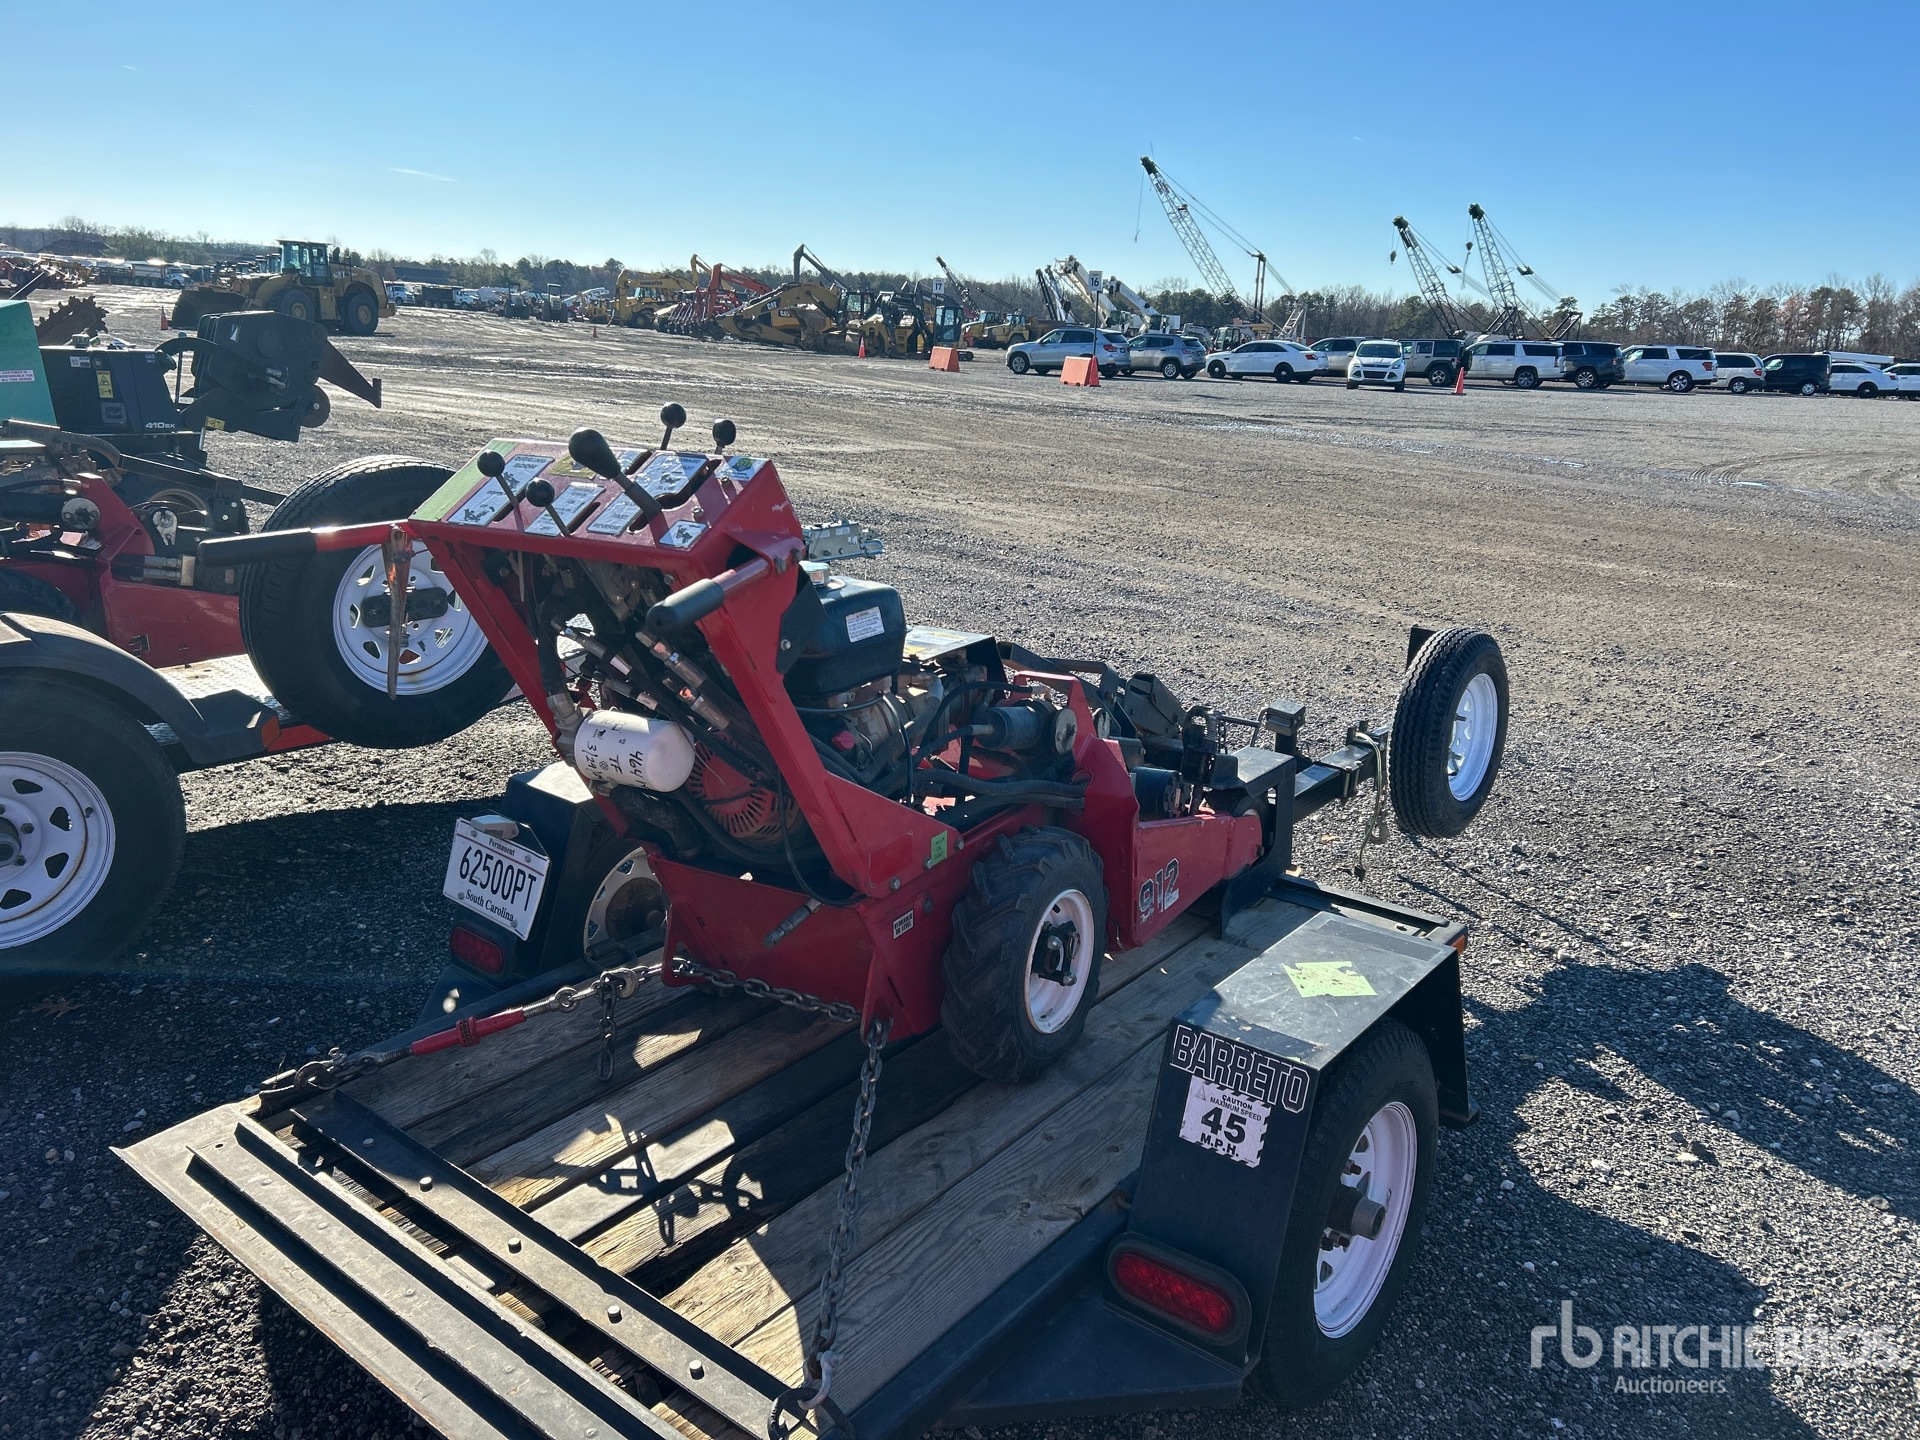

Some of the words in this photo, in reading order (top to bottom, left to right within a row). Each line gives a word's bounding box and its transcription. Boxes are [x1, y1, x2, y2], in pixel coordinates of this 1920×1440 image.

[935, 282, 942, 290] 17
[1091, 277, 1099, 287] 16
[767, 301, 777, 310] CAT
[629, 751, 643, 778] 464
[488, 838, 515, 856] Permanent
[460, 845, 537, 911] 62500PT
[1139, 858, 1179, 922] 912
[466, 889, 484, 907] South
[486, 899, 514, 921] Carolina
[1170, 1024, 1310, 1114] BARRETO
[1210, 1096, 1240, 1113] MAXIMUM
[1240, 1108, 1261, 1121] SPEED
[1222, 1094, 1253, 1111] CAUTION
[1201, 1106, 1247, 1144] 45
[1200, 1132, 1239, 1157] M.P.H.
